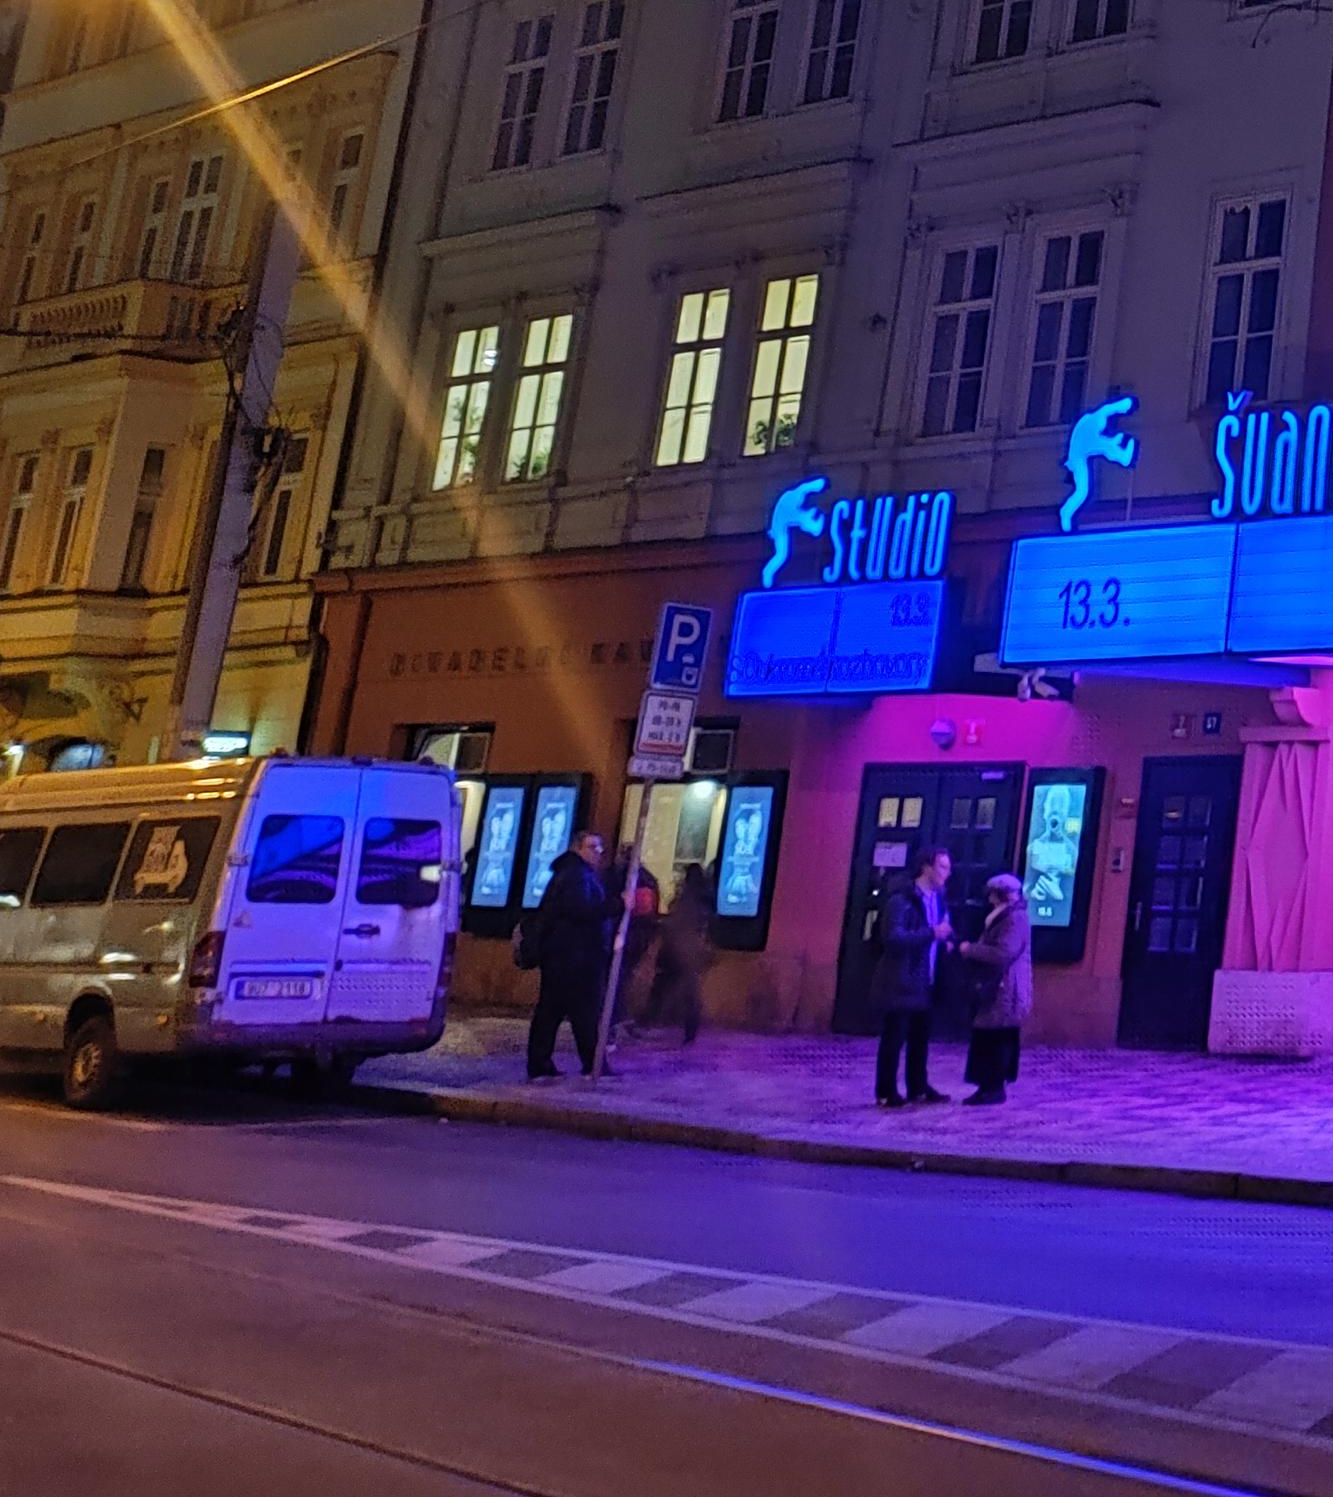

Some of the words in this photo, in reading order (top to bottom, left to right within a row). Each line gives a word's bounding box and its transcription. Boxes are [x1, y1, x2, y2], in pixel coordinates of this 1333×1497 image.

[823, 490, 953, 585] studio
[1057, 577, 1131, 630] 13.3.
[666, 614, 701, 662] P
